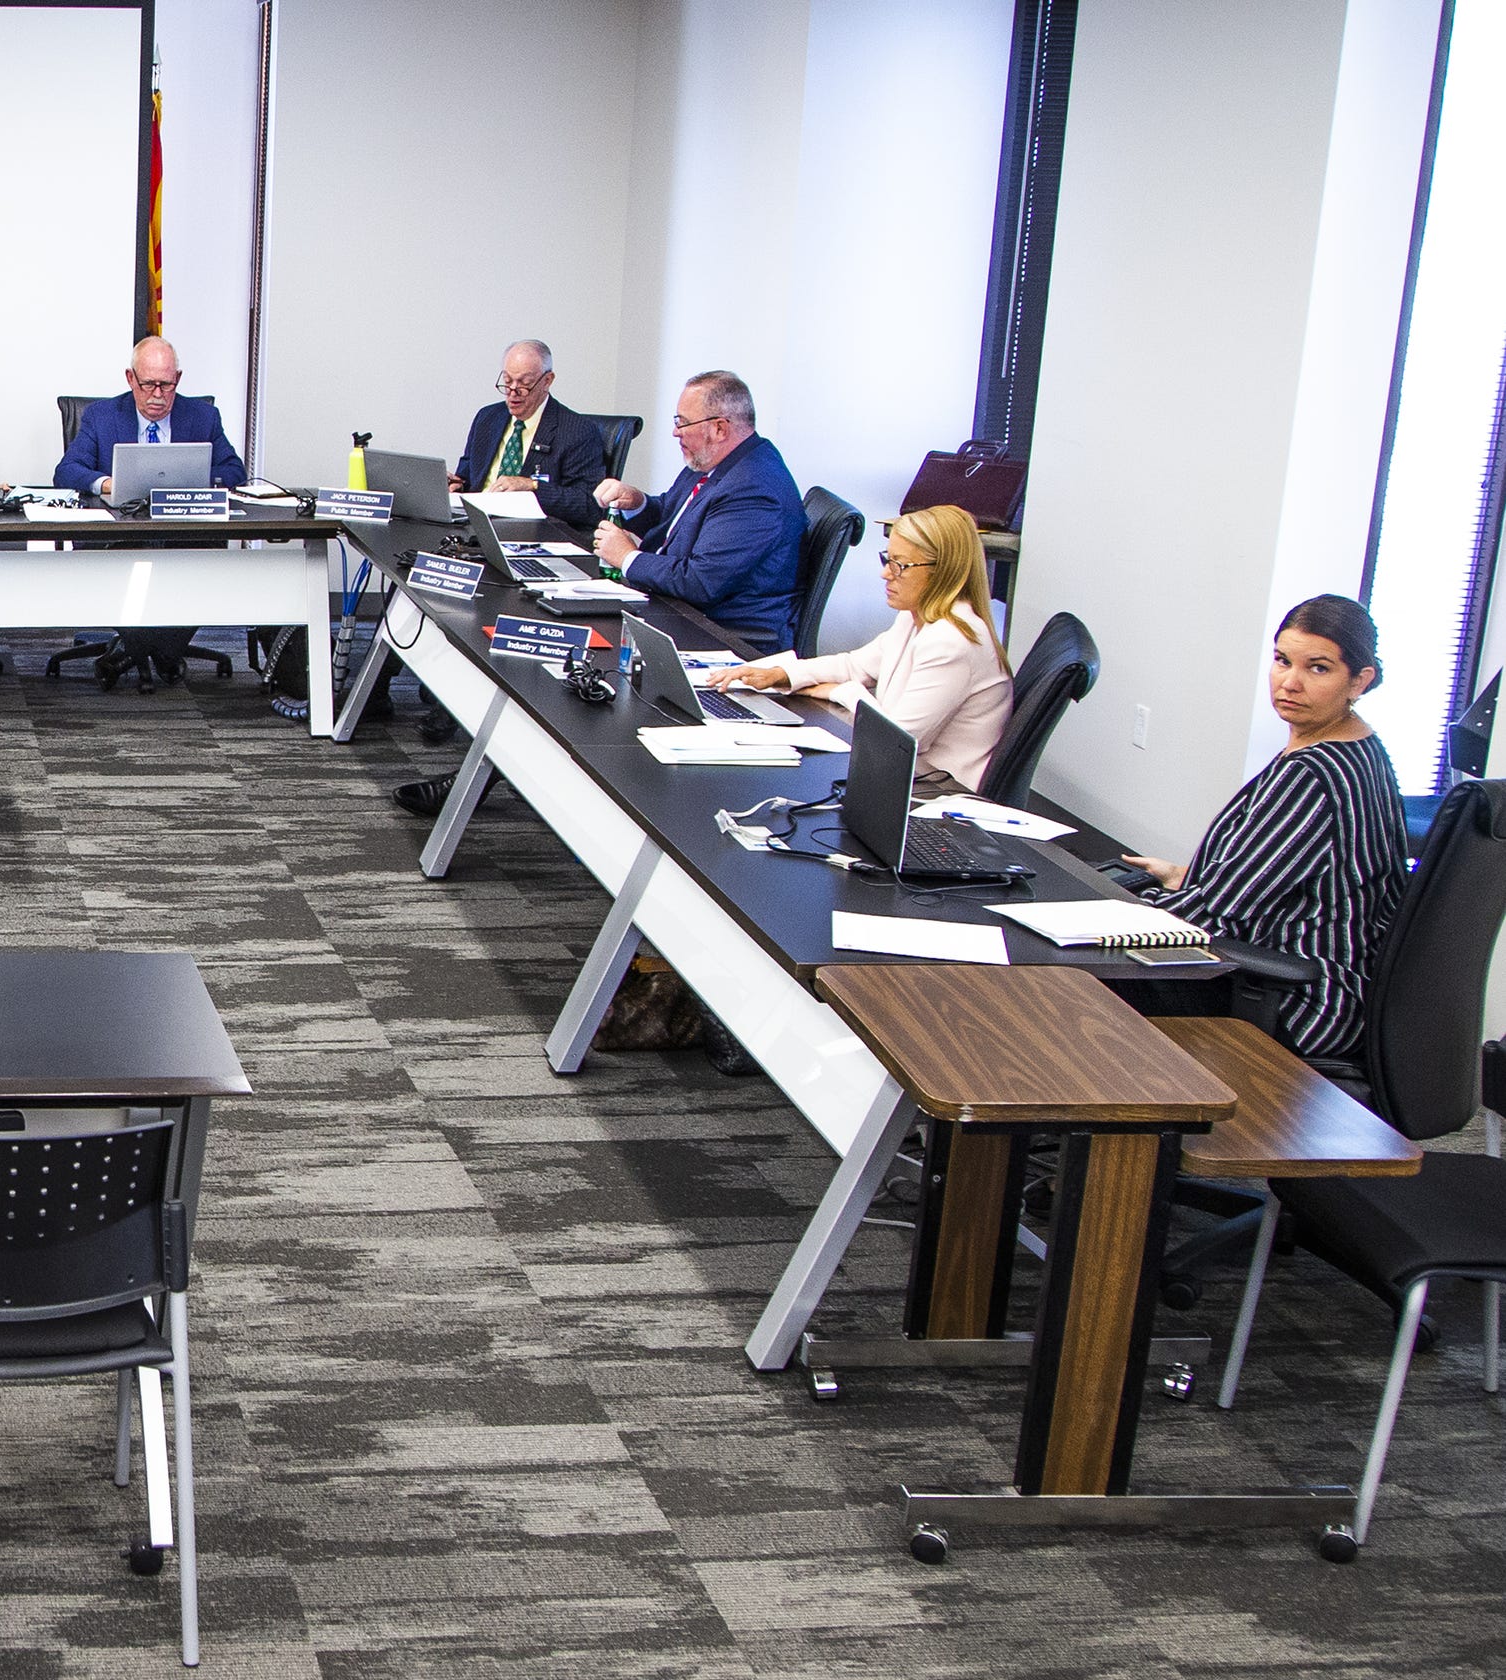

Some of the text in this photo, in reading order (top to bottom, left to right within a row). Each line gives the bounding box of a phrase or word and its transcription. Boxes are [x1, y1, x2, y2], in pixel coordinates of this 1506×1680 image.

[330, 493, 381, 504] JACK PETERSON
[163, 507, 188, 515] Industry
[330, 507, 374, 516] Public Member
[425, 560, 447, 571] SAMUEL
[420, 575, 465, 590] Industry Member
[518, 624, 565, 638] AMIE GAZDA
[507, 640, 569, 657] Industry Member
